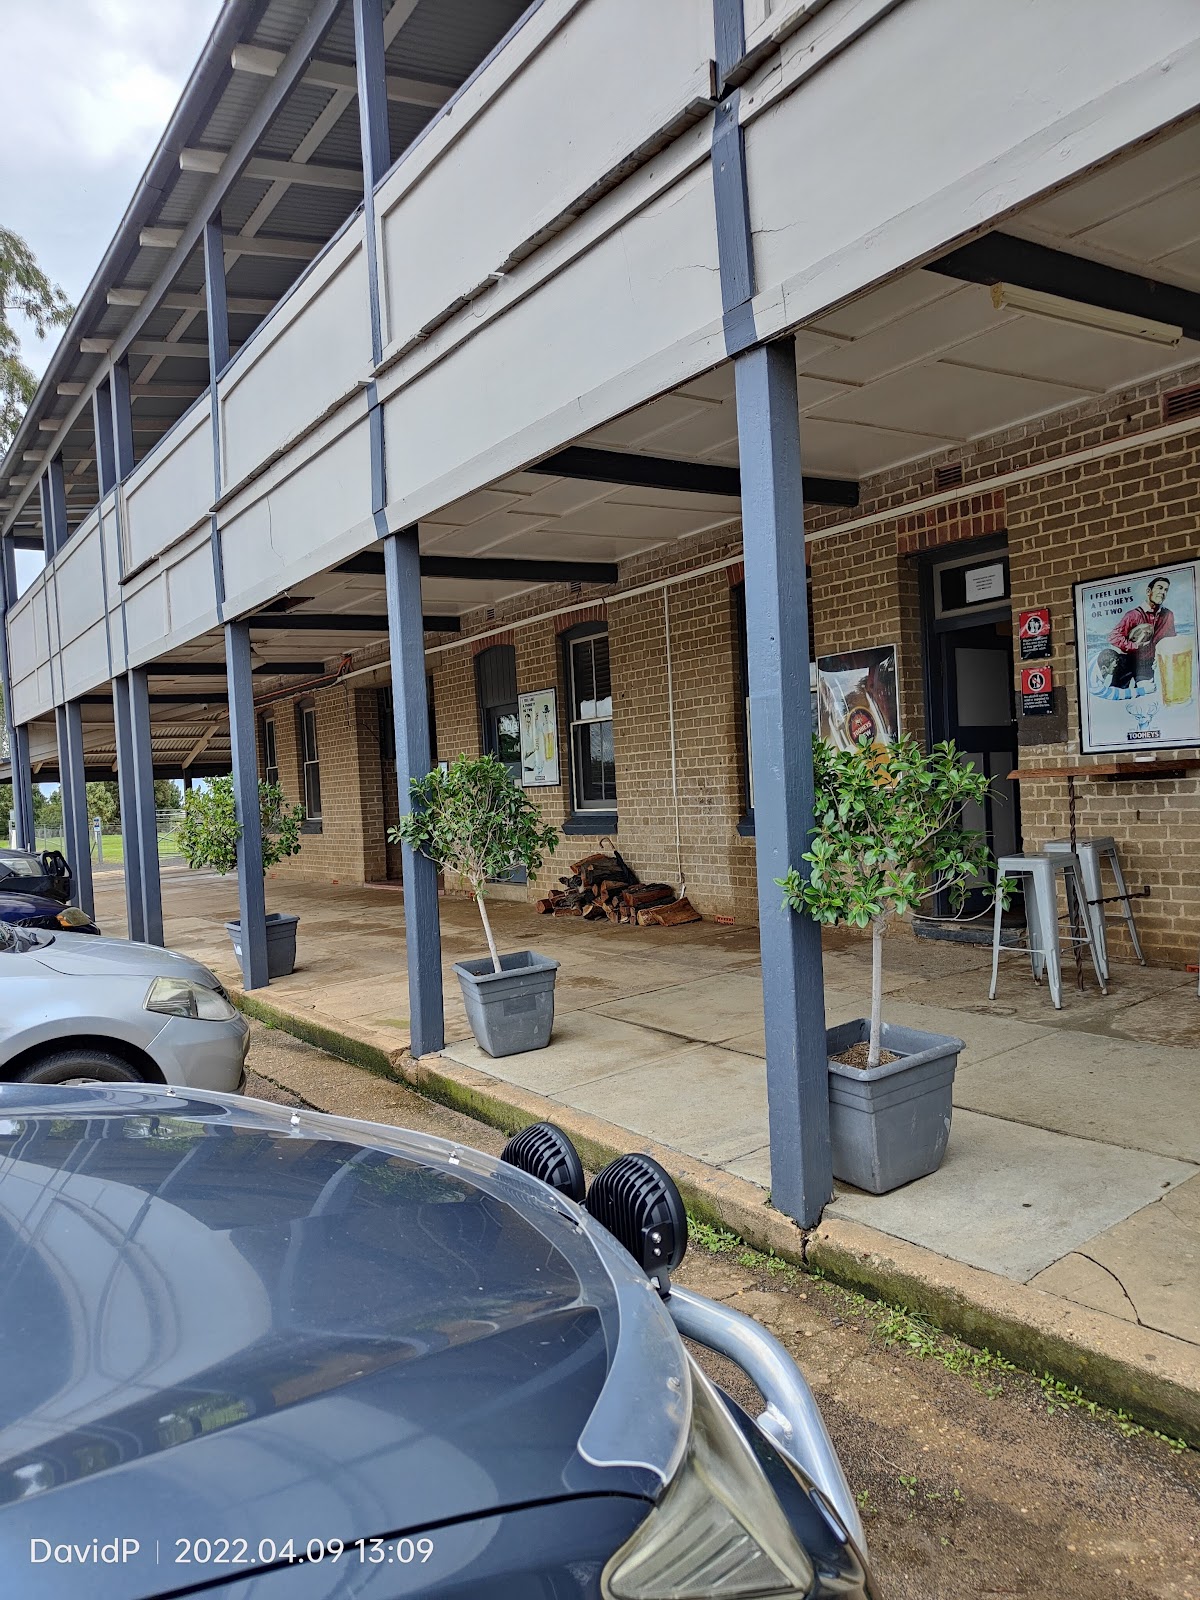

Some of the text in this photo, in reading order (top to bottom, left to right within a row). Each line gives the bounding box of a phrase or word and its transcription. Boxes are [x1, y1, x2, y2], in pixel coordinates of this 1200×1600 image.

[1095, 590, 1112, 599] FEEL
[1114, 587, 1132, 596] LIKE
[1098, 595, 1134, 607] TOOHEYS
[1104, 607, 1123, 615] TWO
[853, 720, 872, 737] TOOHEYS
[1129, 731, 1159, 739] TOOHEYS
